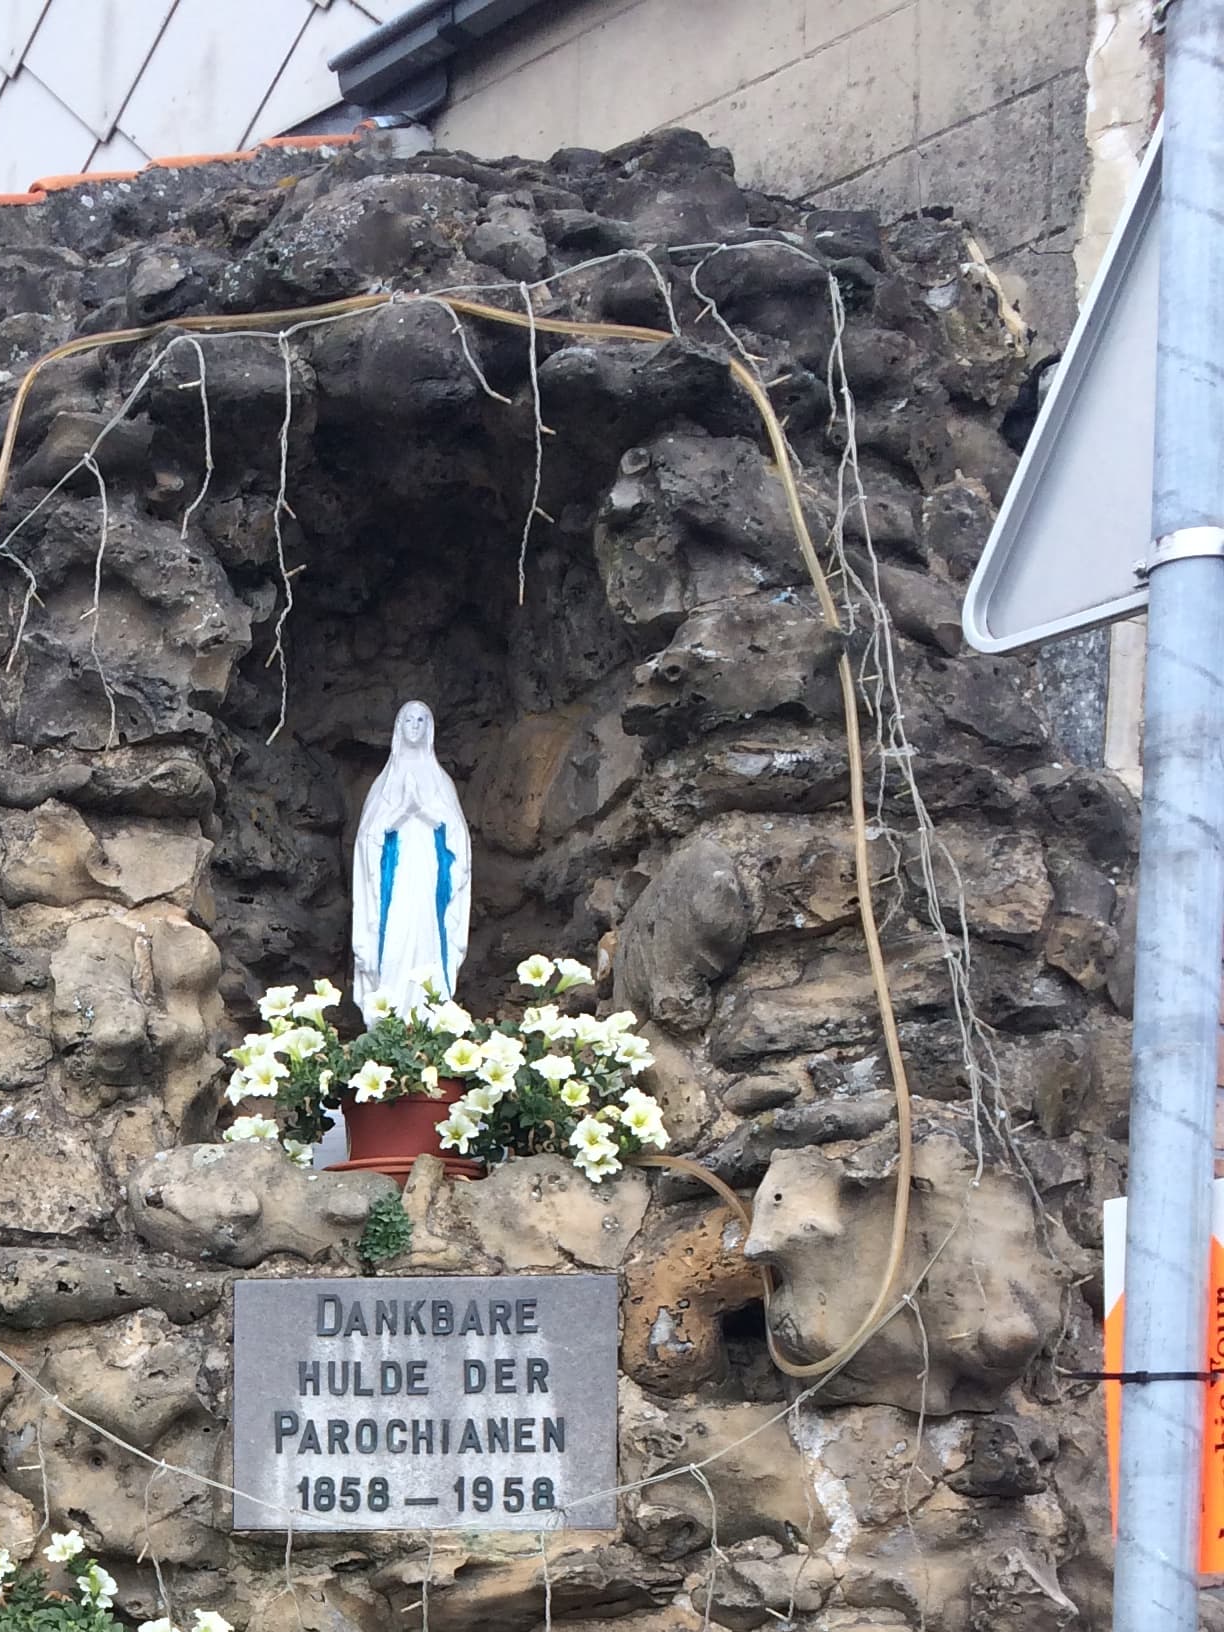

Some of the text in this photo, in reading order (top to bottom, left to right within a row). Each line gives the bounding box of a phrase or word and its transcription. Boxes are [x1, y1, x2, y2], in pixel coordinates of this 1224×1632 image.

[316, 1293, 539, 1337] DANKBARE
[298, 1357, 550, 1396] HULDE DER
[274, 1410, 566, 1455] PAROCHIANEN
[297, 1475, 390, 1513] 1858
[453, 1475, 555, 1514] 1958
